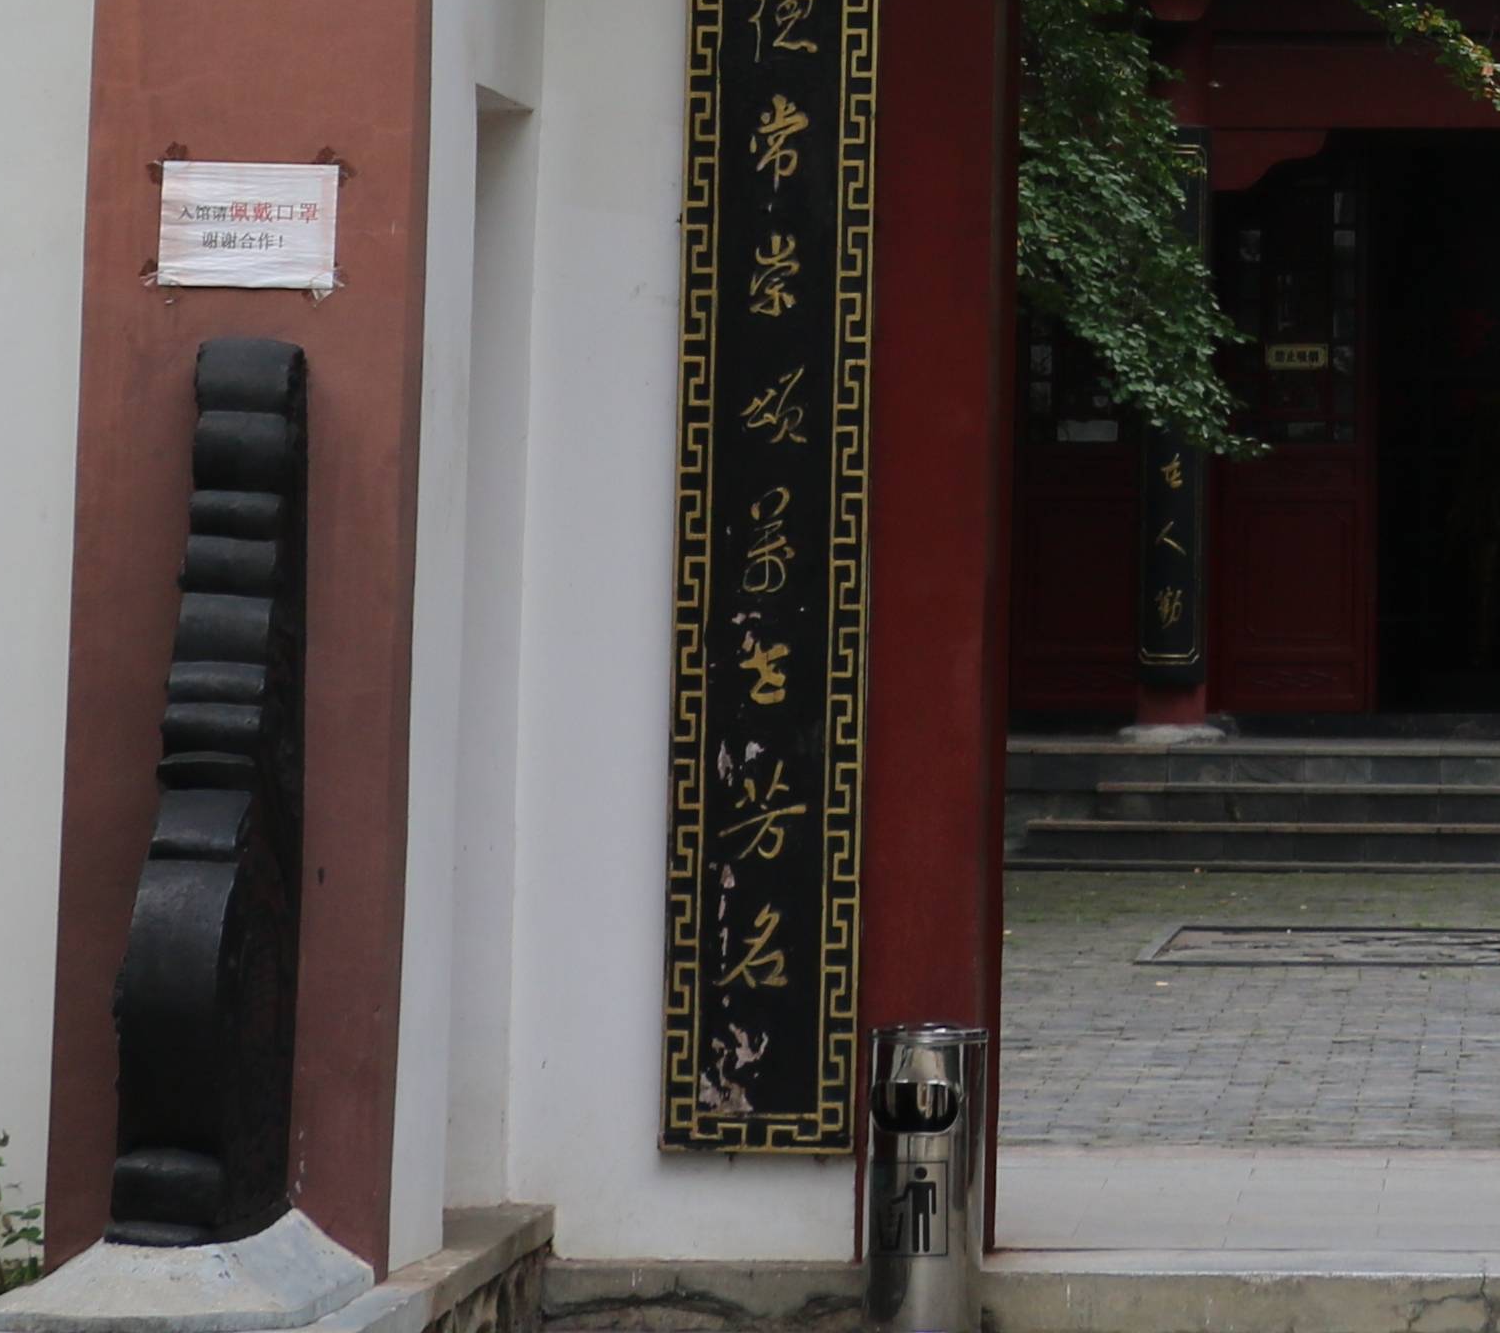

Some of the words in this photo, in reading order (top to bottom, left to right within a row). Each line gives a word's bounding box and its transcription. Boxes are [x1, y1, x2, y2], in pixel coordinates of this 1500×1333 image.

[178, 201, 319, 223] 入馆请佩戴口罩
